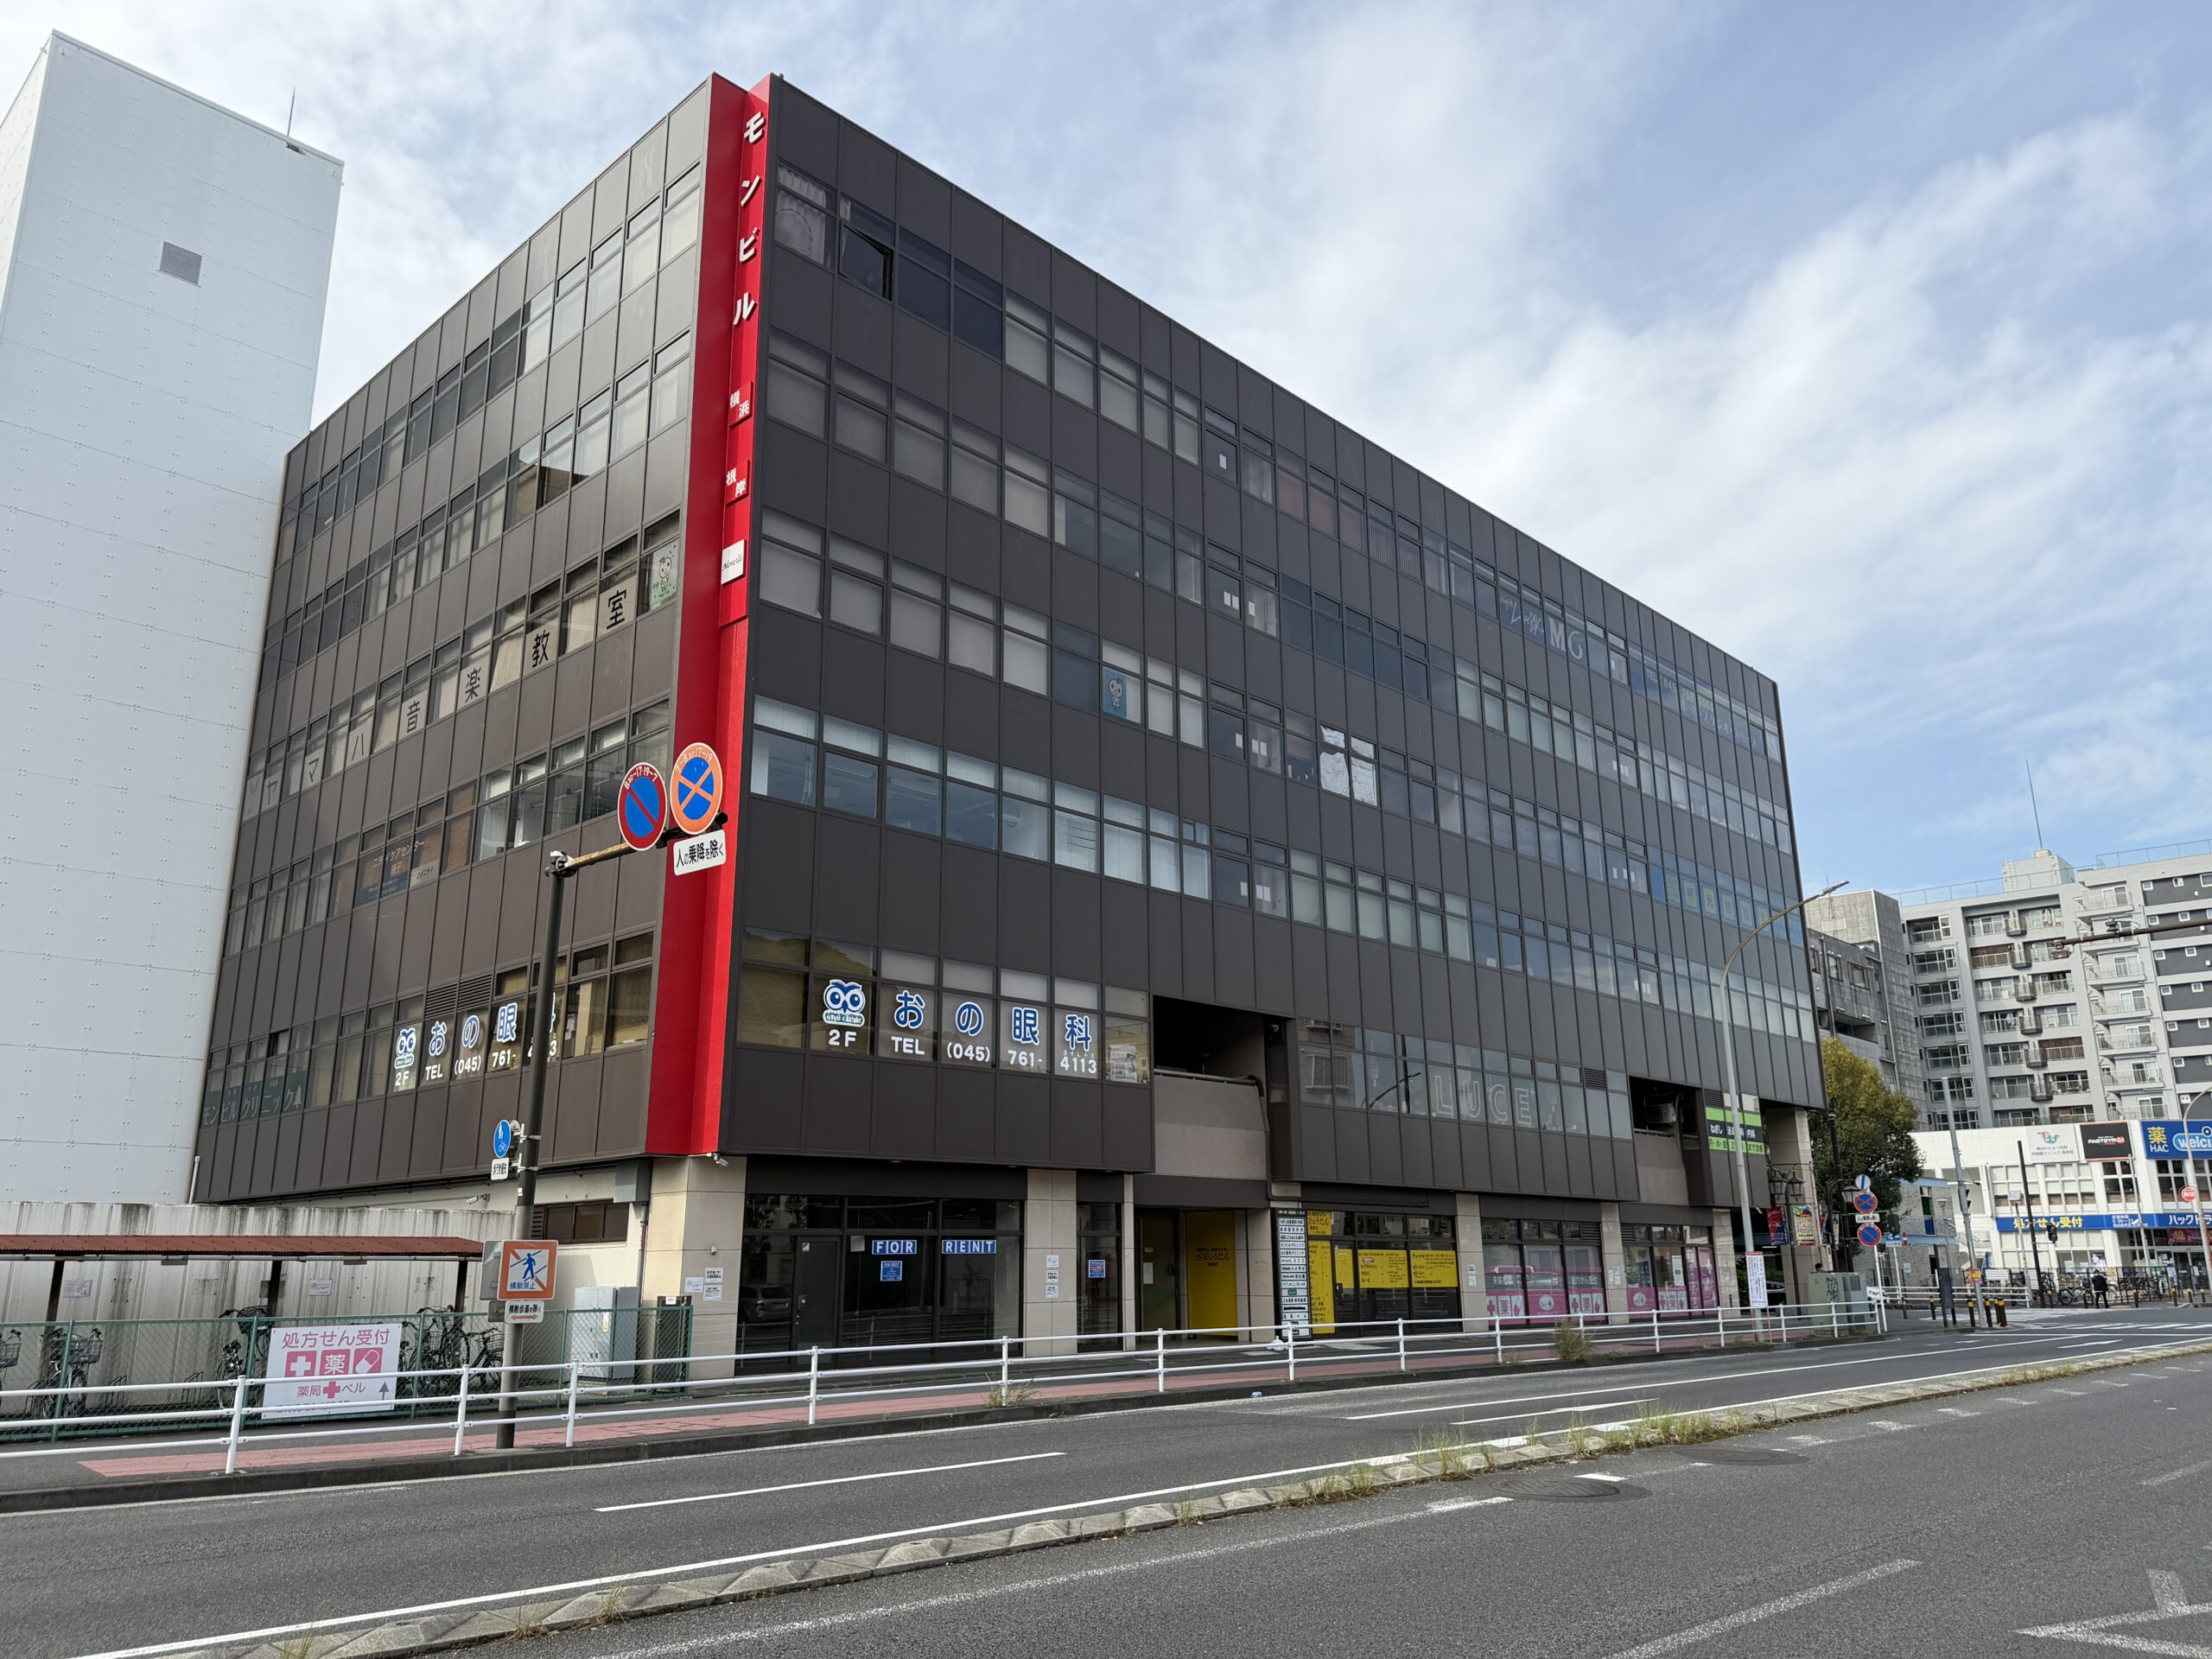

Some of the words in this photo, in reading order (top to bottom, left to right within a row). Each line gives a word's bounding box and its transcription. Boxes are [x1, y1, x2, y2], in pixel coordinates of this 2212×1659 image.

[733, 111, 765, 326] モンビル
[729, 390, 750, 418] 横浜
[726, 467, 747, 497] 根岸
[267, 590, 627, 805] ヤマハ音楽教室
[372, 840, 425, 868] ニチイケアセンター
[676, 839, 724, 868] 人の乗降を除く
[893, 989, 1092, 1052] おの眼科
[829, 1029, 857, 1047] 2F
[425, 1065, 443, 1080] TEL
[454, 1056, 481, 1076] (045)
[492, 1050, 516, 1068] 761-
[527, 1039, 557, 1058] 43
[891, 1036, 925, 1055] TEL
[947, 1042, 991, 1063] (045)
[1008, 1050, 1043, 1068] 761-
[1060, 1056, 1096, 1074] 4113
[395, 1071, 410, 1086] 2F
[202, 1088, 294, 1125] モンビルクリニック
[1433, 1075, 1532, 1124] LUCE
[2147, 1126, 2168, 1144] 薬
[2150, 1144, 2170, 1153] HAC
[876, 1241, 913, 1253] FOR
[946, 1241, 994, 1253] RENT
[510, 1281, 536, 1290] 横断禁止
[509, 1304, 541, 1313] 横断歩道を除く
[1500, 1300, 1509, 1314] 薬
[282, 1328, 391, 1350] 処方せん受付
[324, 1353, 346, 1375] 薬
[297, 1385, 322, 1398] 薬局
[341, 1382, 365, 1395] ベル
